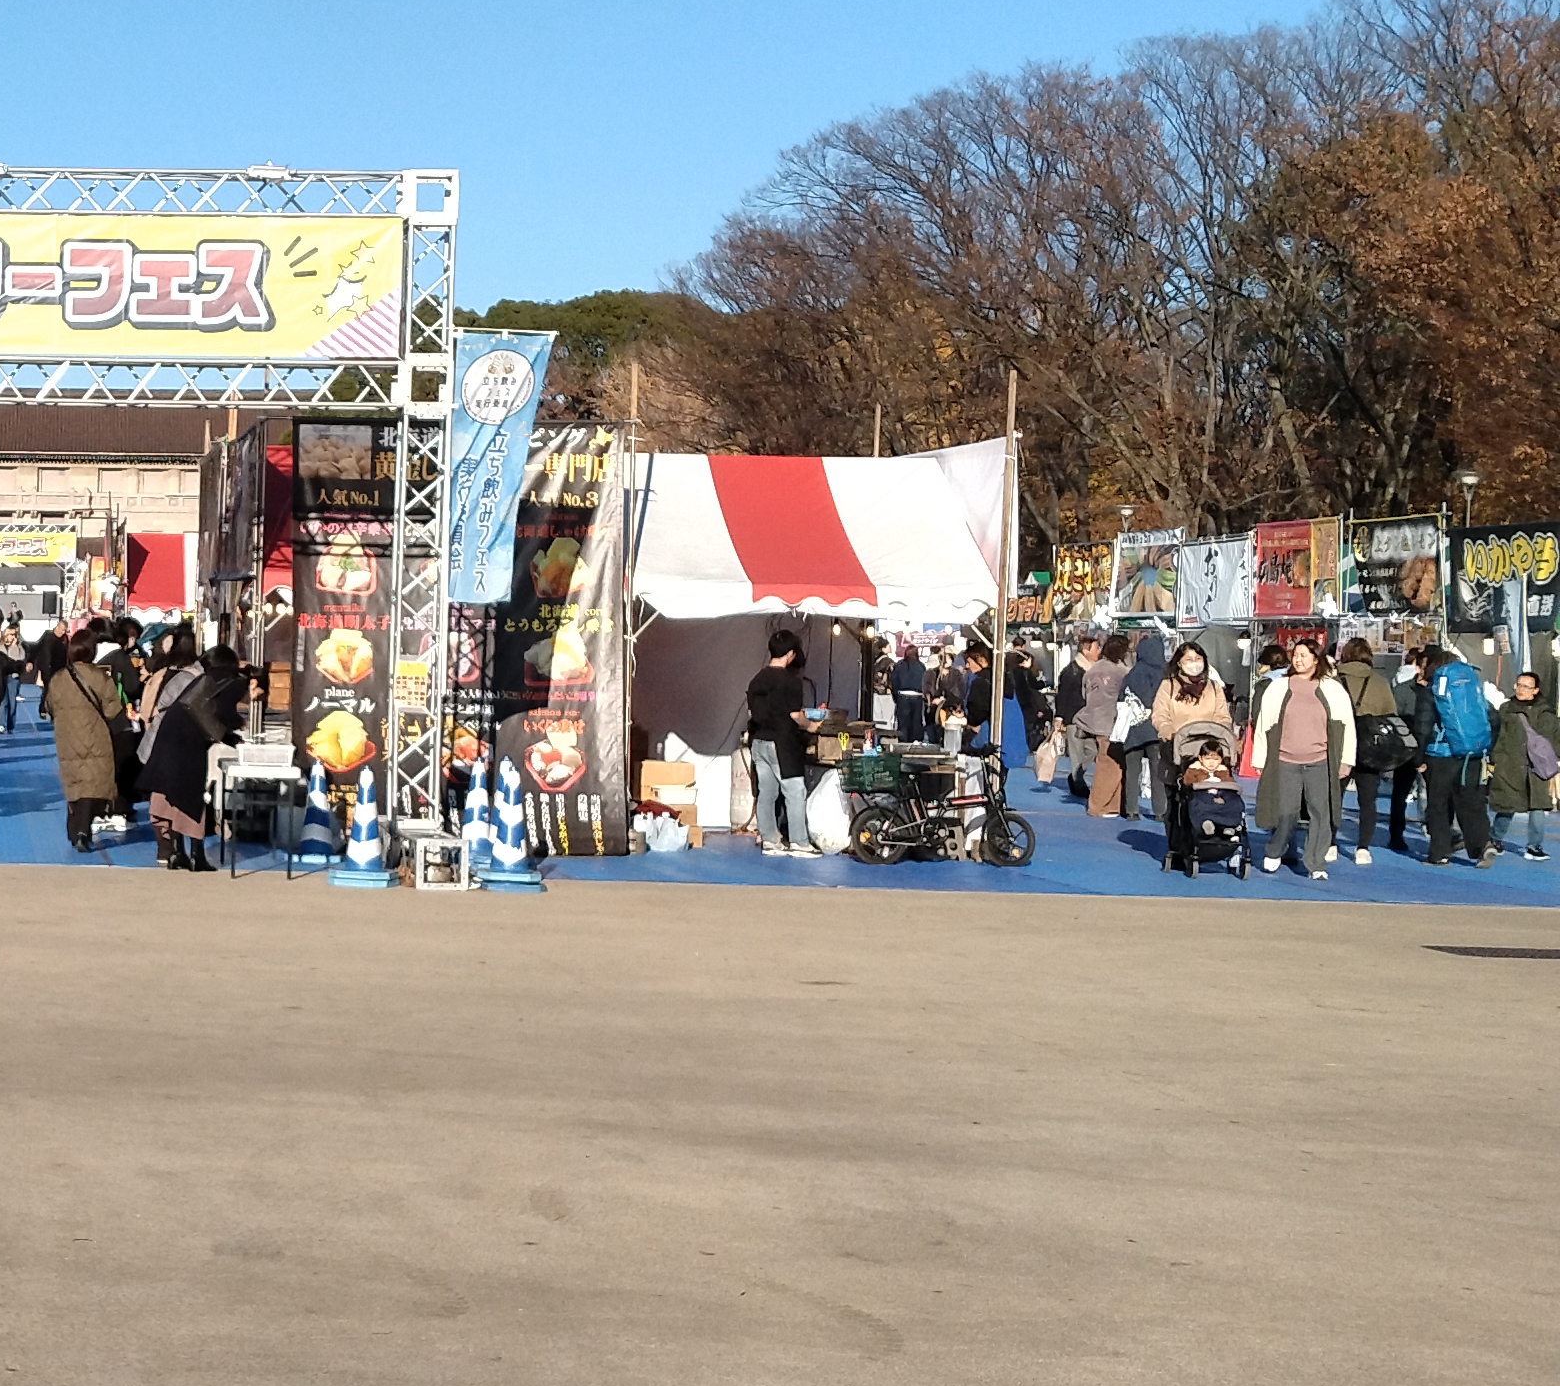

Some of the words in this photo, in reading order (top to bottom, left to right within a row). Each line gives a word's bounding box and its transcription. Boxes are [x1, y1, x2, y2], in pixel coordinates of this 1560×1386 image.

[474, 428, 511, 594] 立ち飲みフェス
[324, 685, 356, 698] plane
[304, 697, 376, 714] ノーマル
